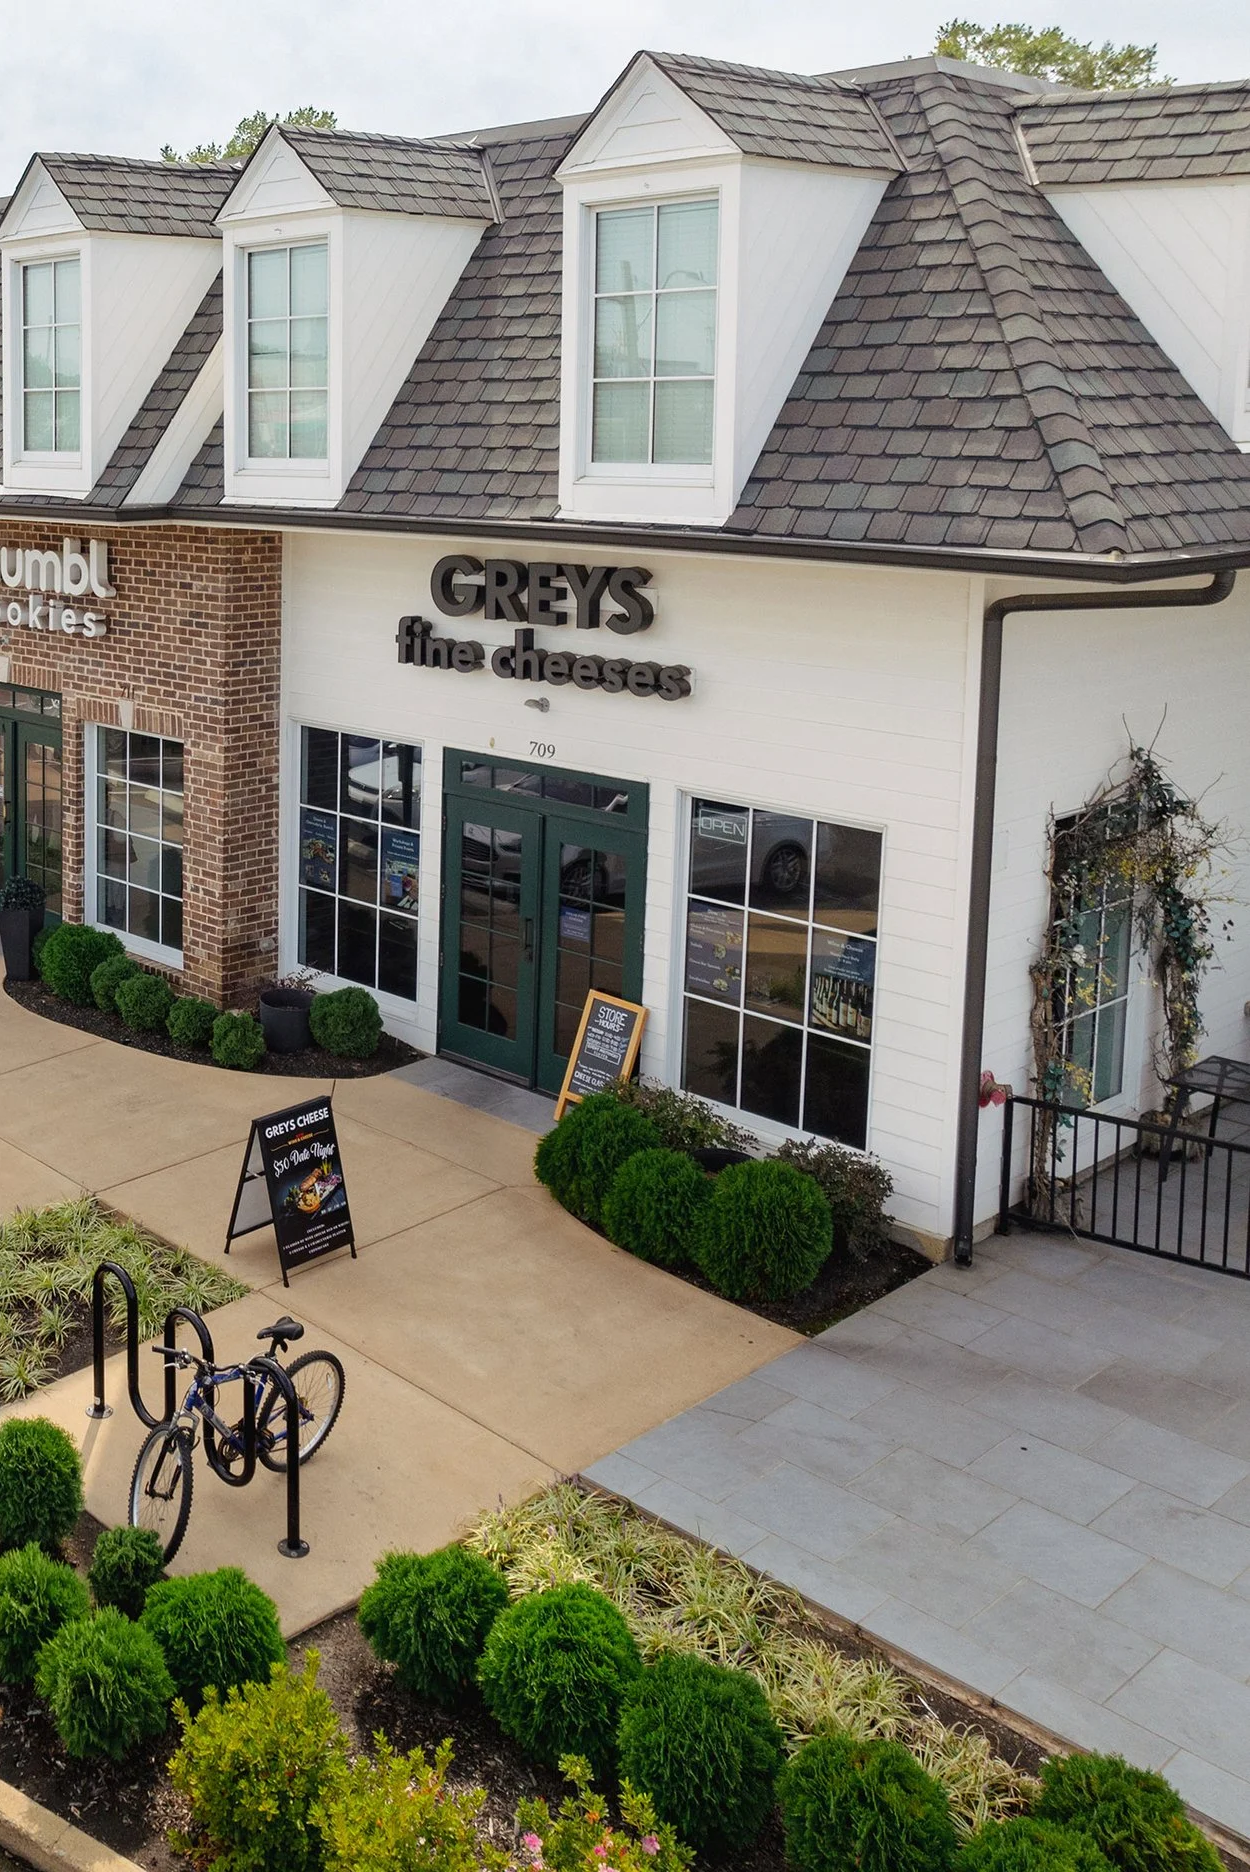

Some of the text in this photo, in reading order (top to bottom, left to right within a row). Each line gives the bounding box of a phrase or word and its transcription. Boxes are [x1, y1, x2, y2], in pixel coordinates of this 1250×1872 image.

[431, 554, 654, 636] GREYS
[396, 615, 692, 701] fine cheeses
[529, 741, 556, 759] 709
[701, 816, 745, 837] OPEN
[598, 1006, 628, 1027] STORE
[574, 1070, 591, 1084] CHEESE
[265, 1107, 329, 1139] GREYS CHEESE
[290, 1149, 310, 1166] Date
[310, 1142, 336, 1160] Night
